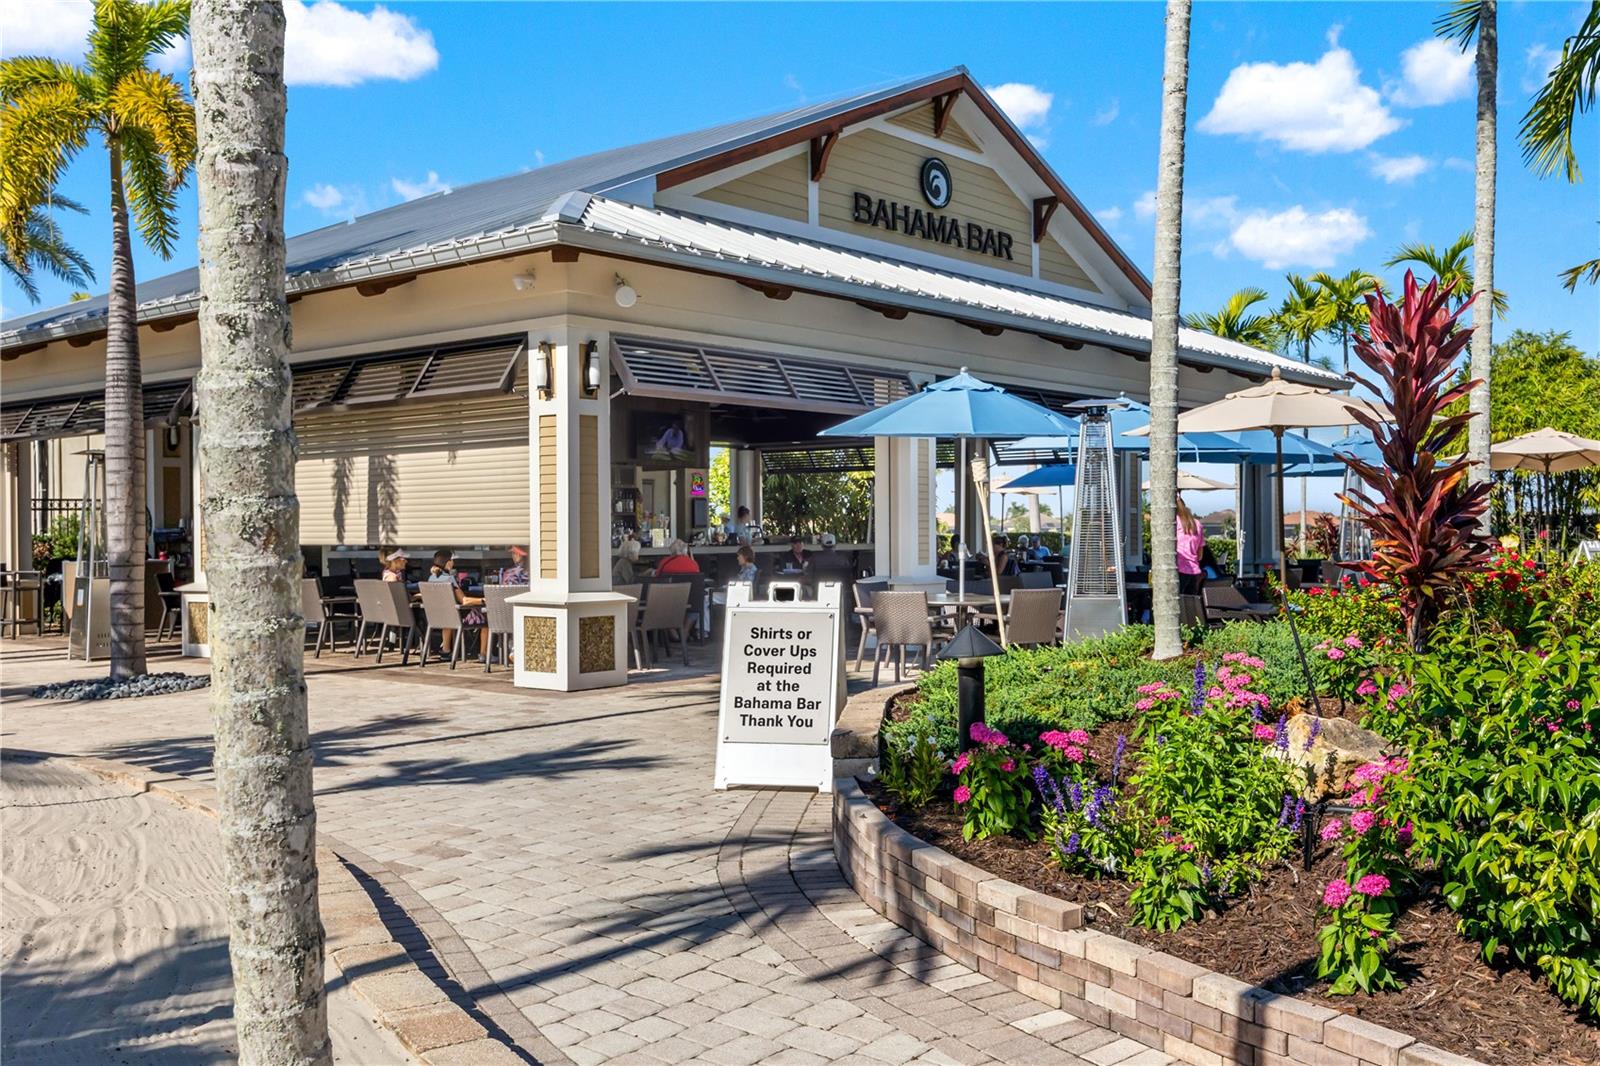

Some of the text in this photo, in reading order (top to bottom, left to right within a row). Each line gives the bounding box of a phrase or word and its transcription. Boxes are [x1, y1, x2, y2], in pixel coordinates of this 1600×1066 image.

[853, 191, 1014, 261] BAHAMA BAR
[750, 627, 813, 640] Shirts or
[743, 644, 817, 661] Cover Ups
[747, 662, 812, 678] Required
[756, 680, 800, 692] at the
[734, 697, 822, 710] Bahama Bar
[739, 714, 813, 728] Thank You
